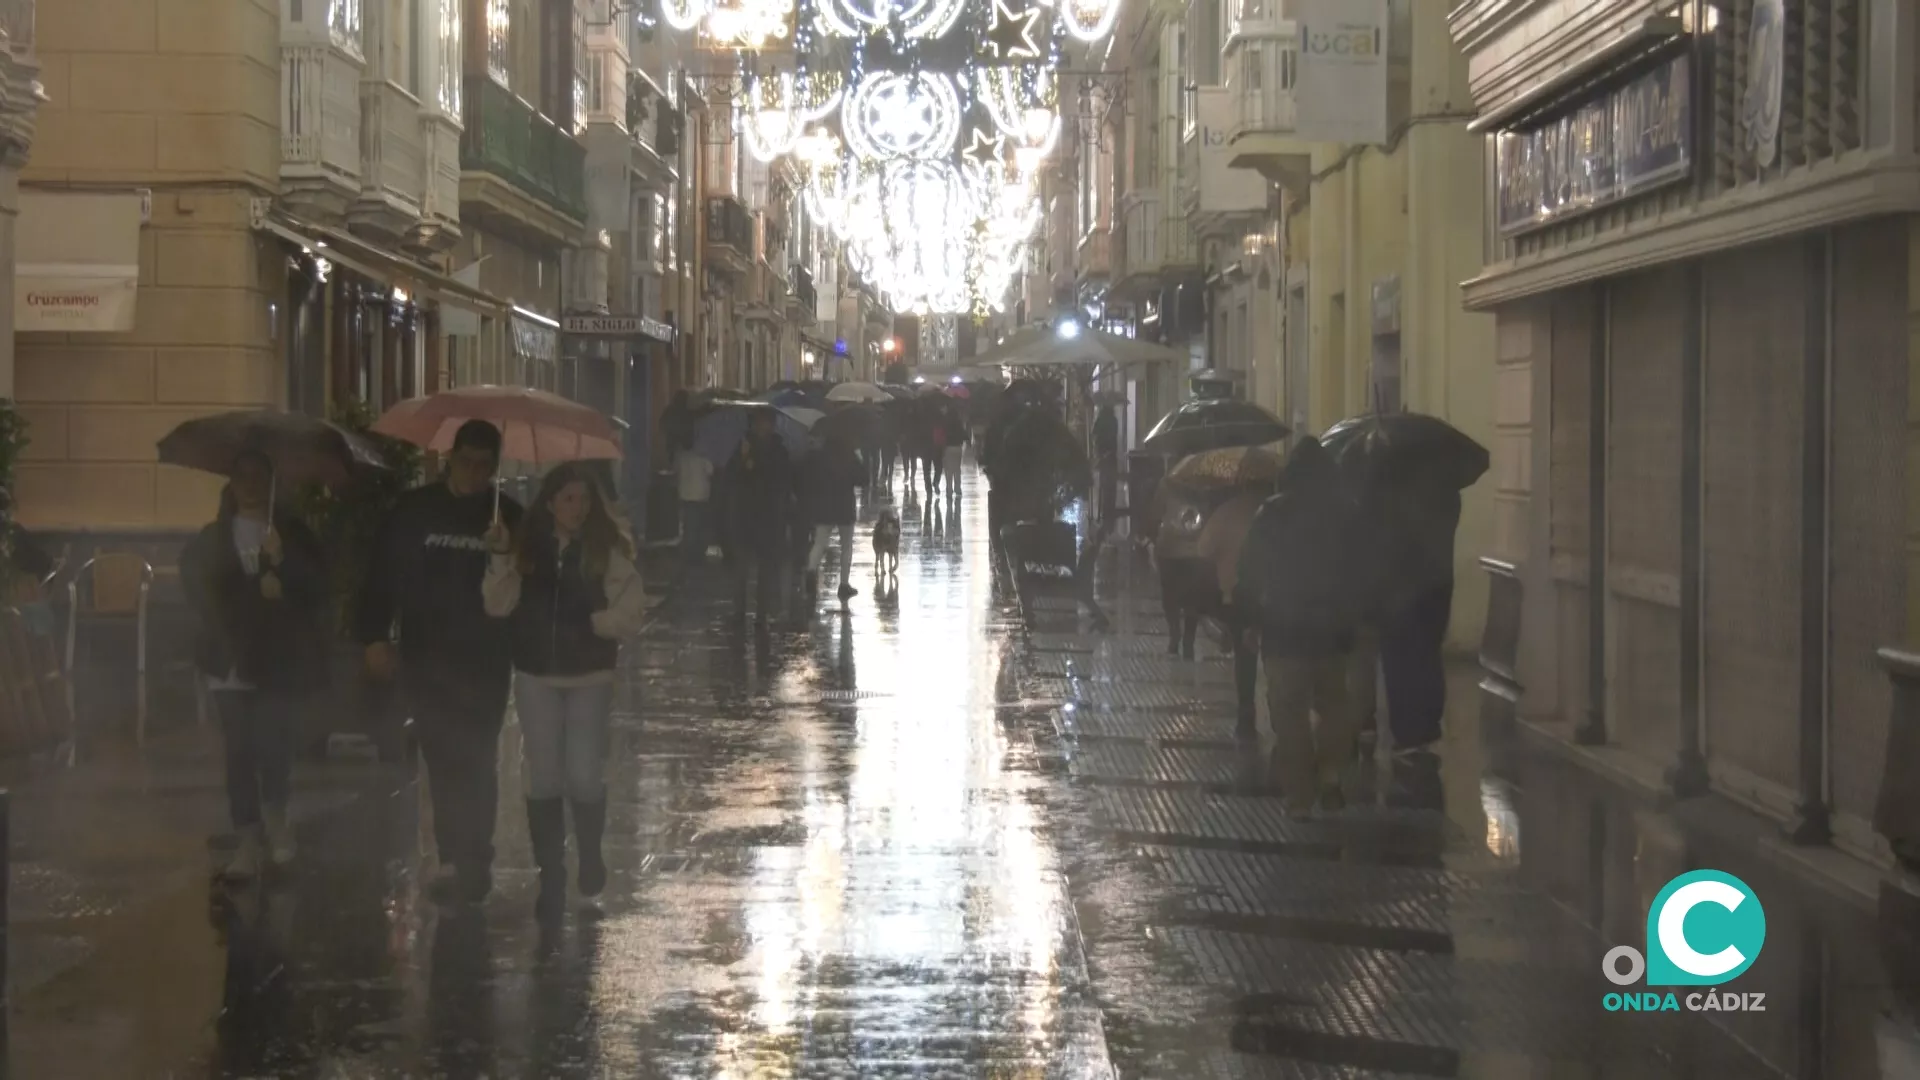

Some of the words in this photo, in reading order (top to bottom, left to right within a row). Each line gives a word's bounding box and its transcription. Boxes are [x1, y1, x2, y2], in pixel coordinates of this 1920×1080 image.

[27, 291, 99, 308] Cruzcampo
[569, 319, 588, 330] EL
[592, 319, 636, 331] SIGLO
